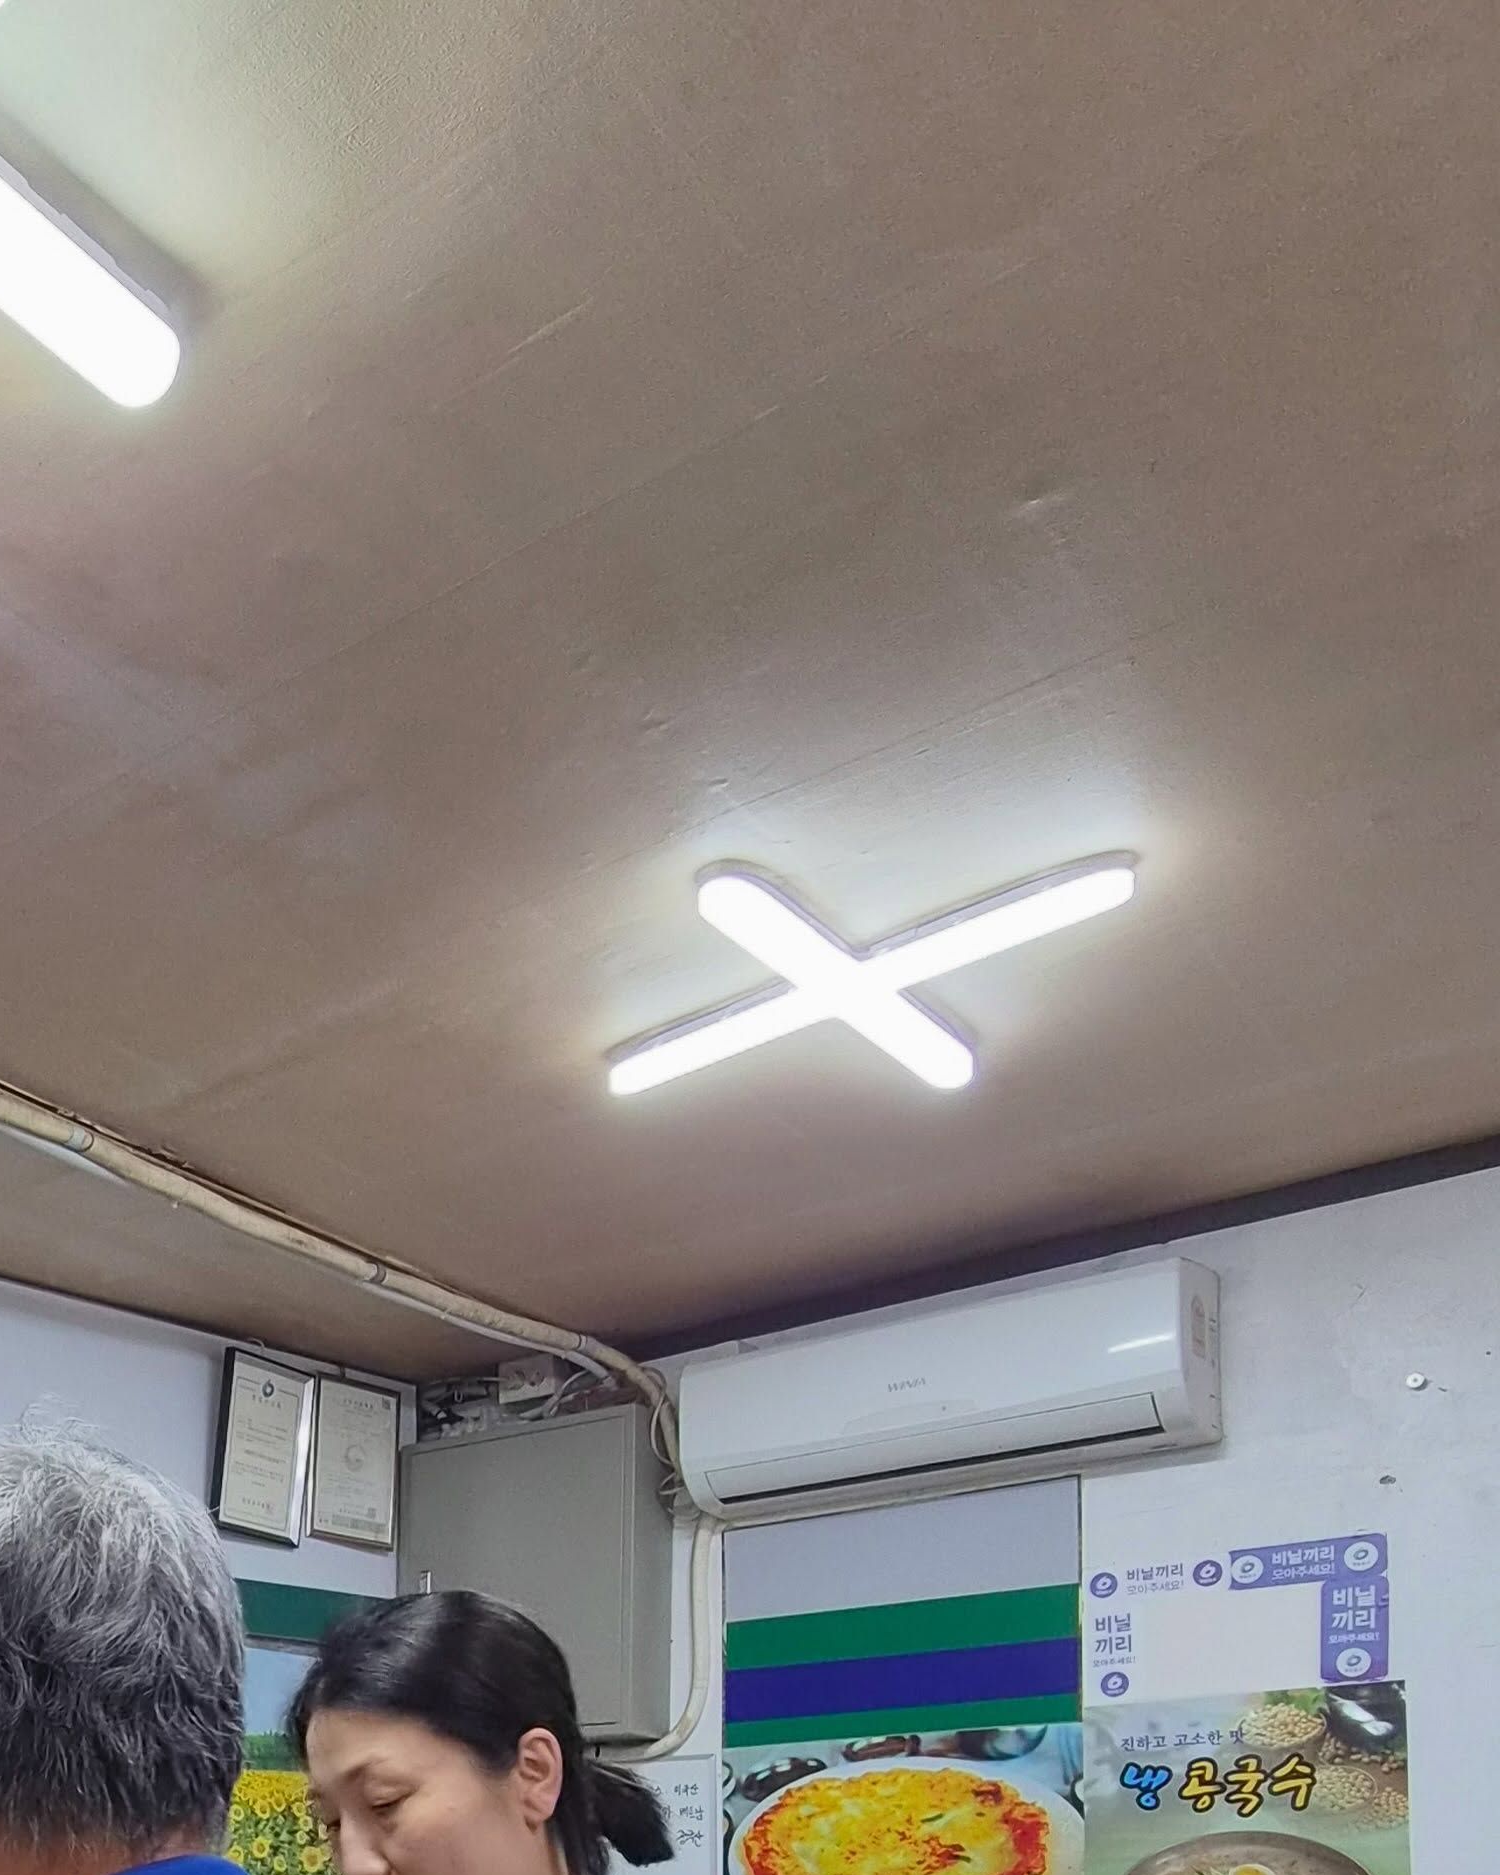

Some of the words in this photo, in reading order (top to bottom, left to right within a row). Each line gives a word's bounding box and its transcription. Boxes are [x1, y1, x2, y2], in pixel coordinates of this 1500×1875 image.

[1271, 1545, 1335, 1567] 비닐끼리
[1126, 1562, 1184, 1582] 비닐끼리
[1271, 1562, 1336, 1581] 모아주세요!
[1126, 1579, 1185, 1596] 모아주세요!
[1331, 1585, 1377, 1607] 비닐
[1094, 1613, 1132, 1634] 비닐
[1330, 1607, 1376, 1631] 끼리
[1094, 1634, 1133, 1655] 끼리
[1120, 1735, 1168, 1751] 진하고
[1173, 1730, 1224, 1747] 고소한
[1229, 1727, 1247, 1745] 맛
[1120, 1762, 1174, 1811] 냉
[1178, 1752, 1317, 1818] 콩국수
